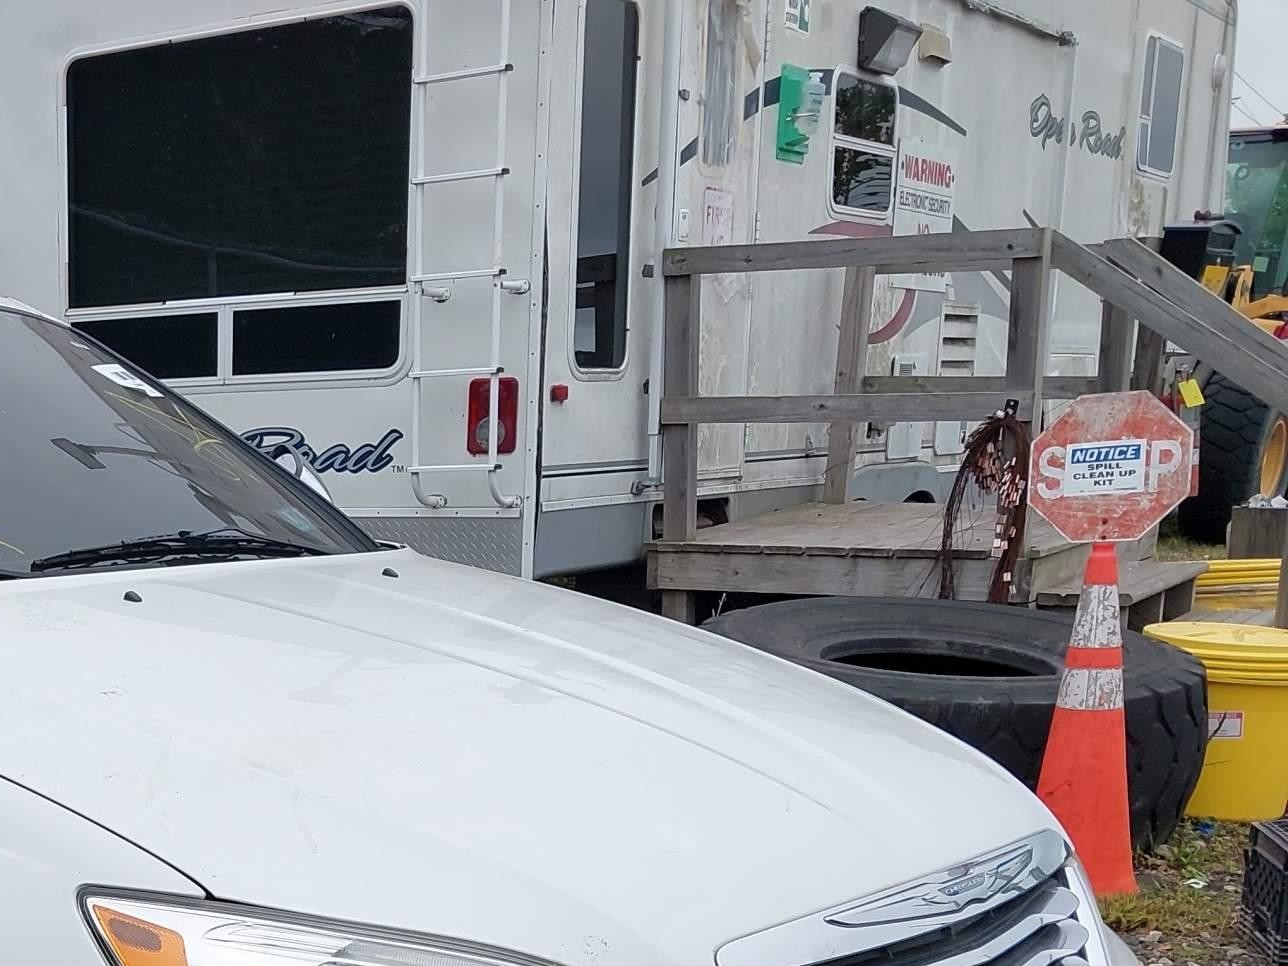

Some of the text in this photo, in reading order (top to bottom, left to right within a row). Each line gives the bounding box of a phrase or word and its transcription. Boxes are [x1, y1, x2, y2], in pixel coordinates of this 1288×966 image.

[1079, 110, 1126, 159] Road
[904, 154, 951, 188] WARNING
[899, 190, 951, 216] ELECTRONIC SECURITY
[1073, 446, 1139, 462] NOTICE
[1072, 469, 1137, 480] CLEAN UP
[1087, 462, 1123, 471] SPILL
[1092, 478, 1116, 487] KIT
